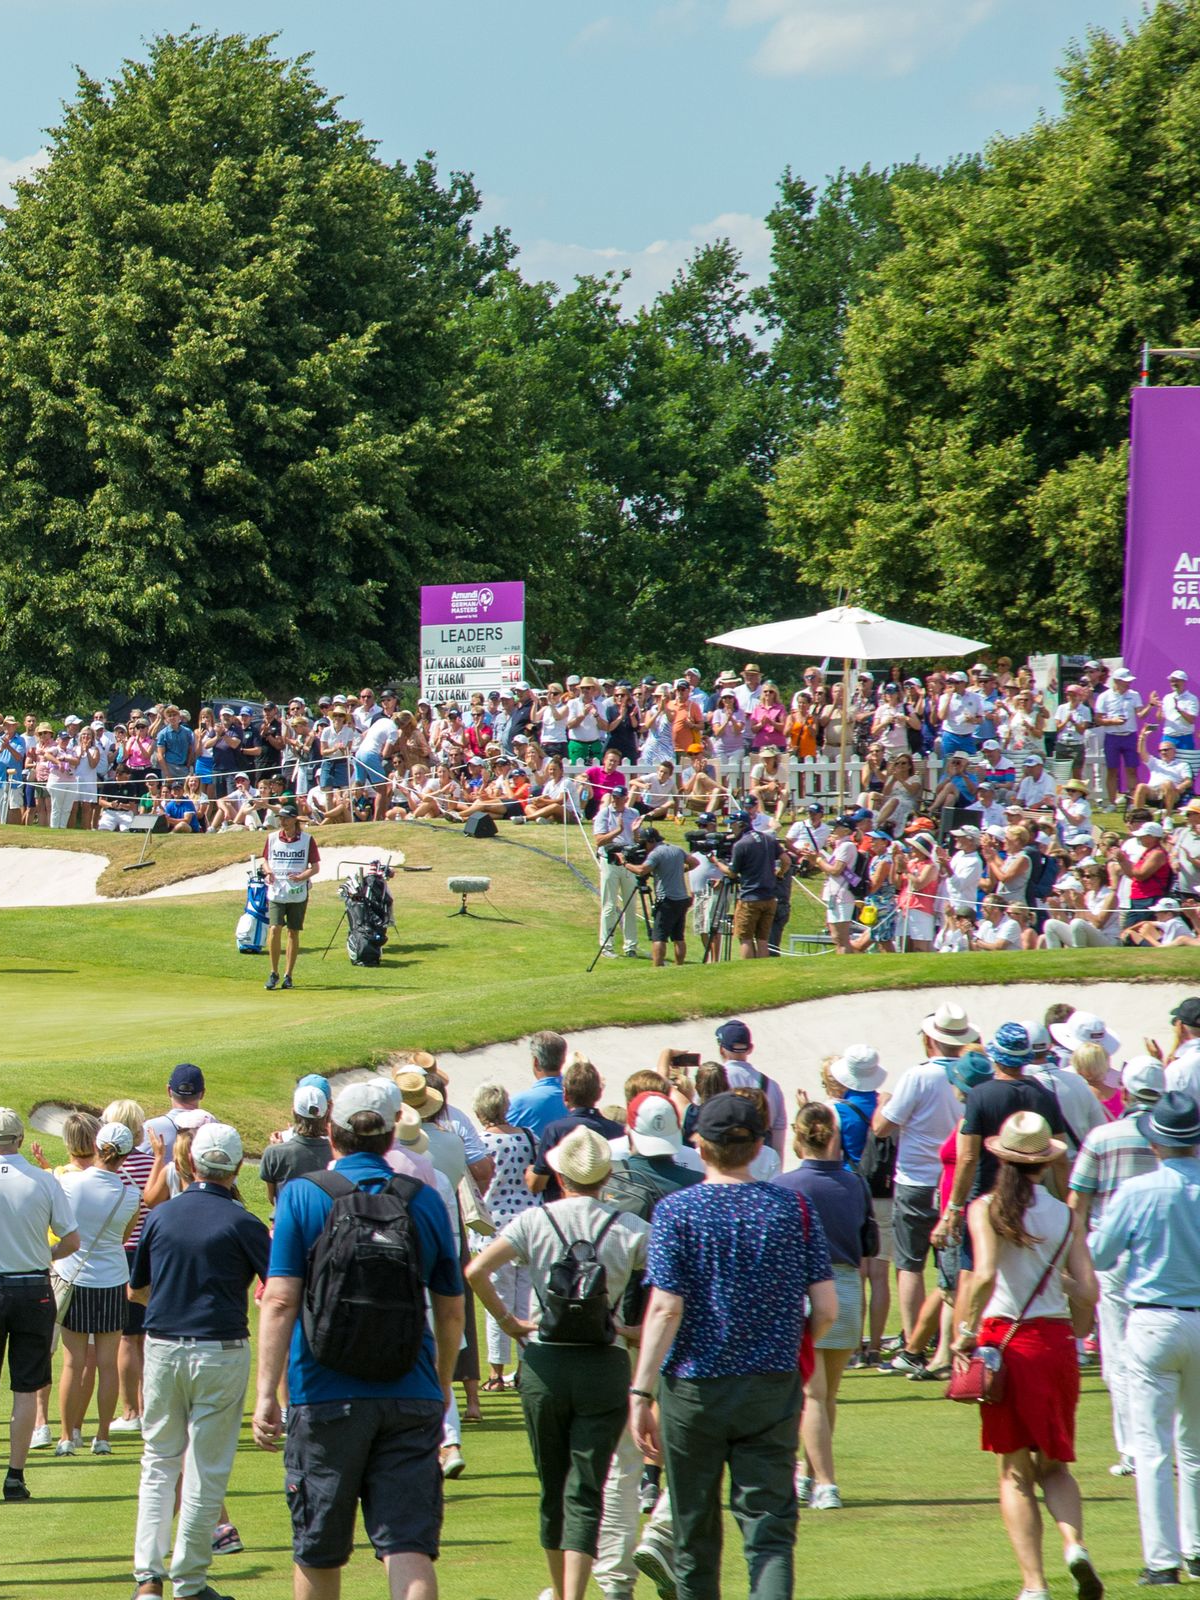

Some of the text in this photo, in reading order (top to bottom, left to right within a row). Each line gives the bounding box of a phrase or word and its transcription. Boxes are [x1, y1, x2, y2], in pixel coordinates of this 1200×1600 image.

[451, 590, 478, 600] Amundi
[441, 627, 503, 642] LEADERS
[457, 645, 486, 653] PLAYER
[425, 658, 435, 669] 17
[437, 656, 485, 669] KARLSSON
[438, 673, 465, 685] HARM
[438, 689, 468, 700] STARK
[273, 849, 305, 858] Amundi
